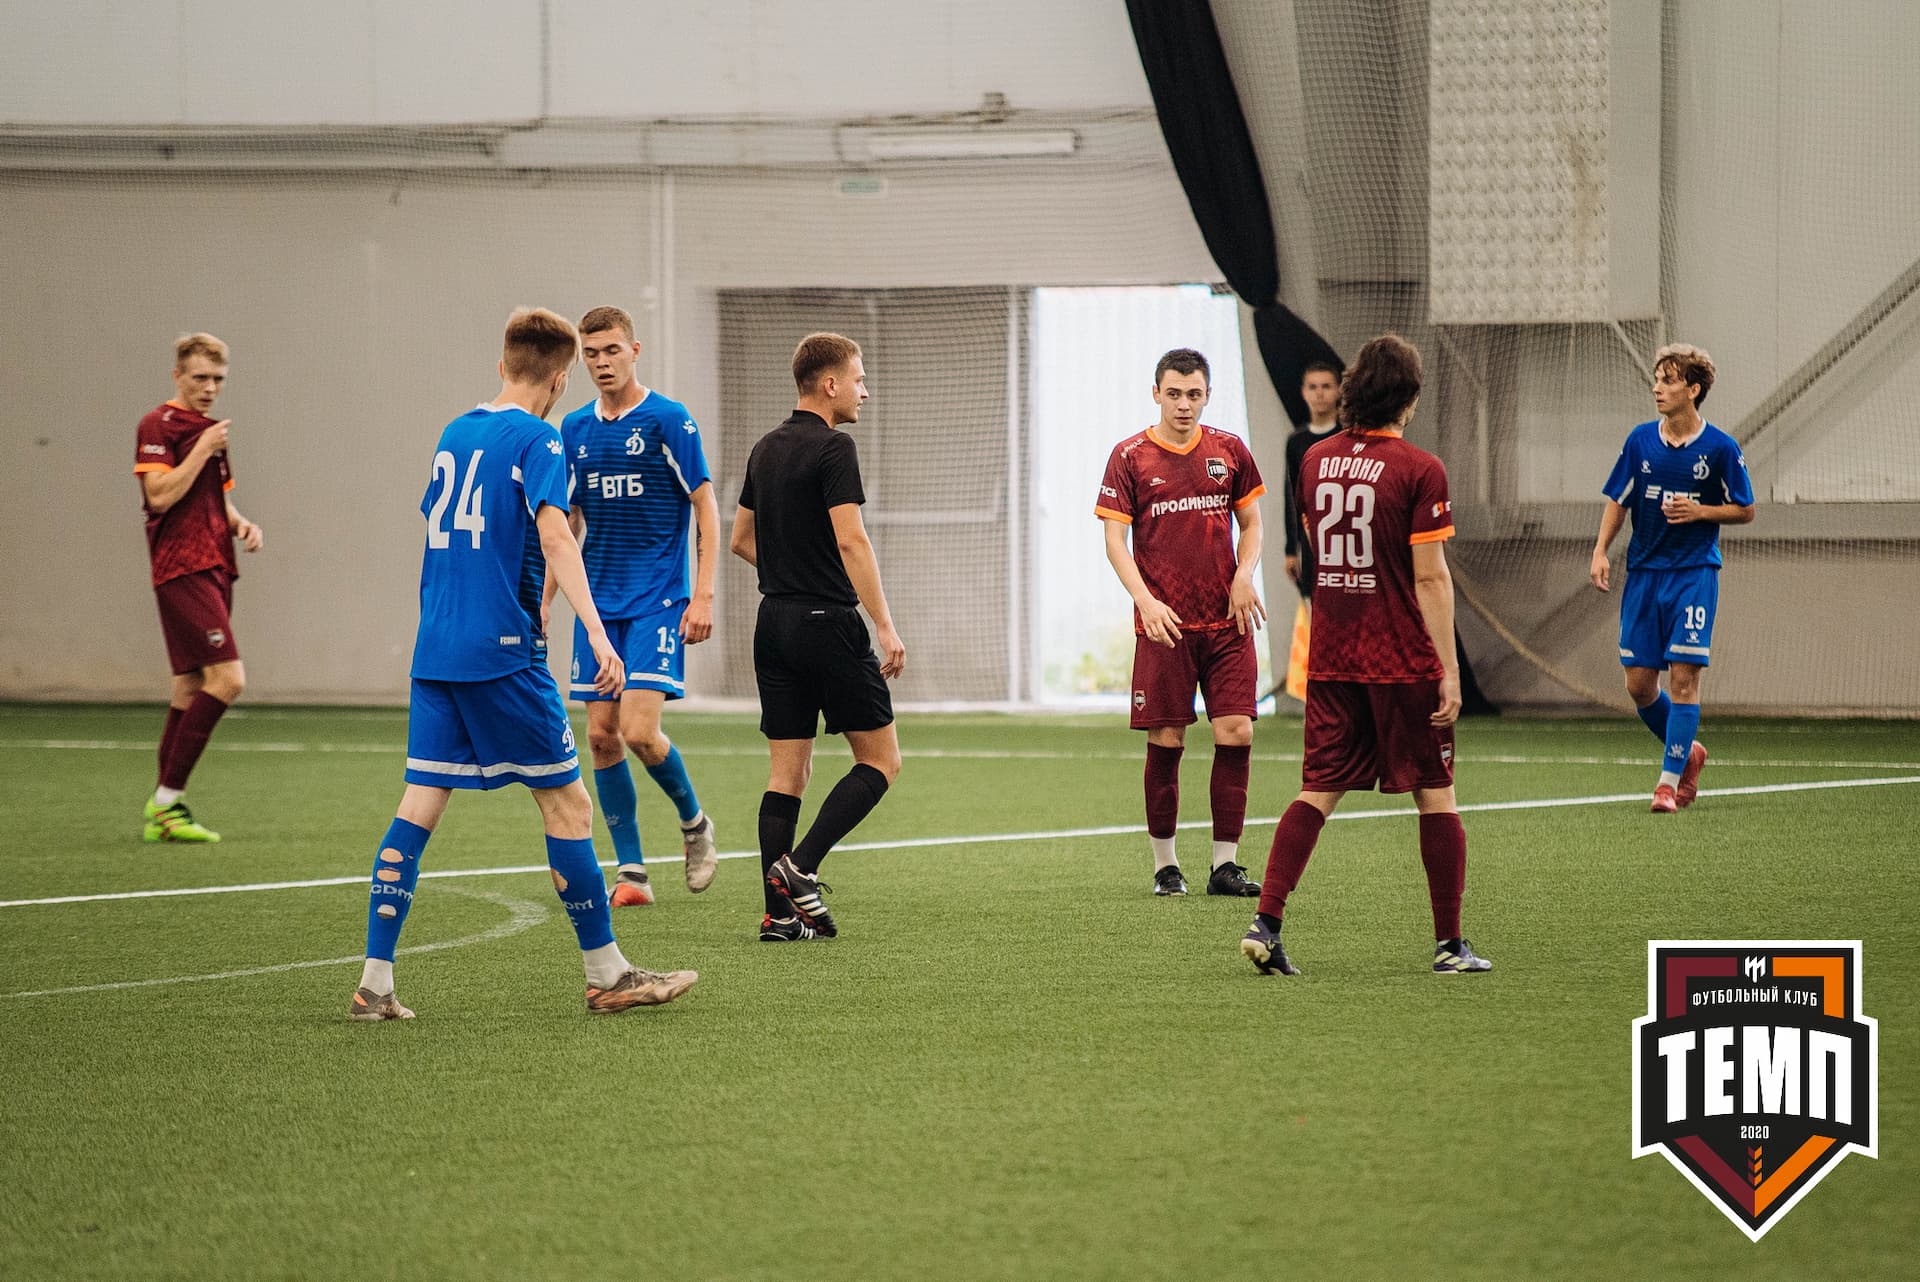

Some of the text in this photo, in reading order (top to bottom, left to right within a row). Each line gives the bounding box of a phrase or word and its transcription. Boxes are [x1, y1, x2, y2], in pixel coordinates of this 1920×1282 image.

[1317, 455, 1386, 484] ВОРОНА
[427, 449, 486, 550] 24
[601, 473, 645, 499] ВТБ
[1315, 482, 1376, 569] 23
[1317, 571, 1377, 589] SEUS
[1684, 604, 1706, 630] 19
[656, 626, 676, 655] 15
